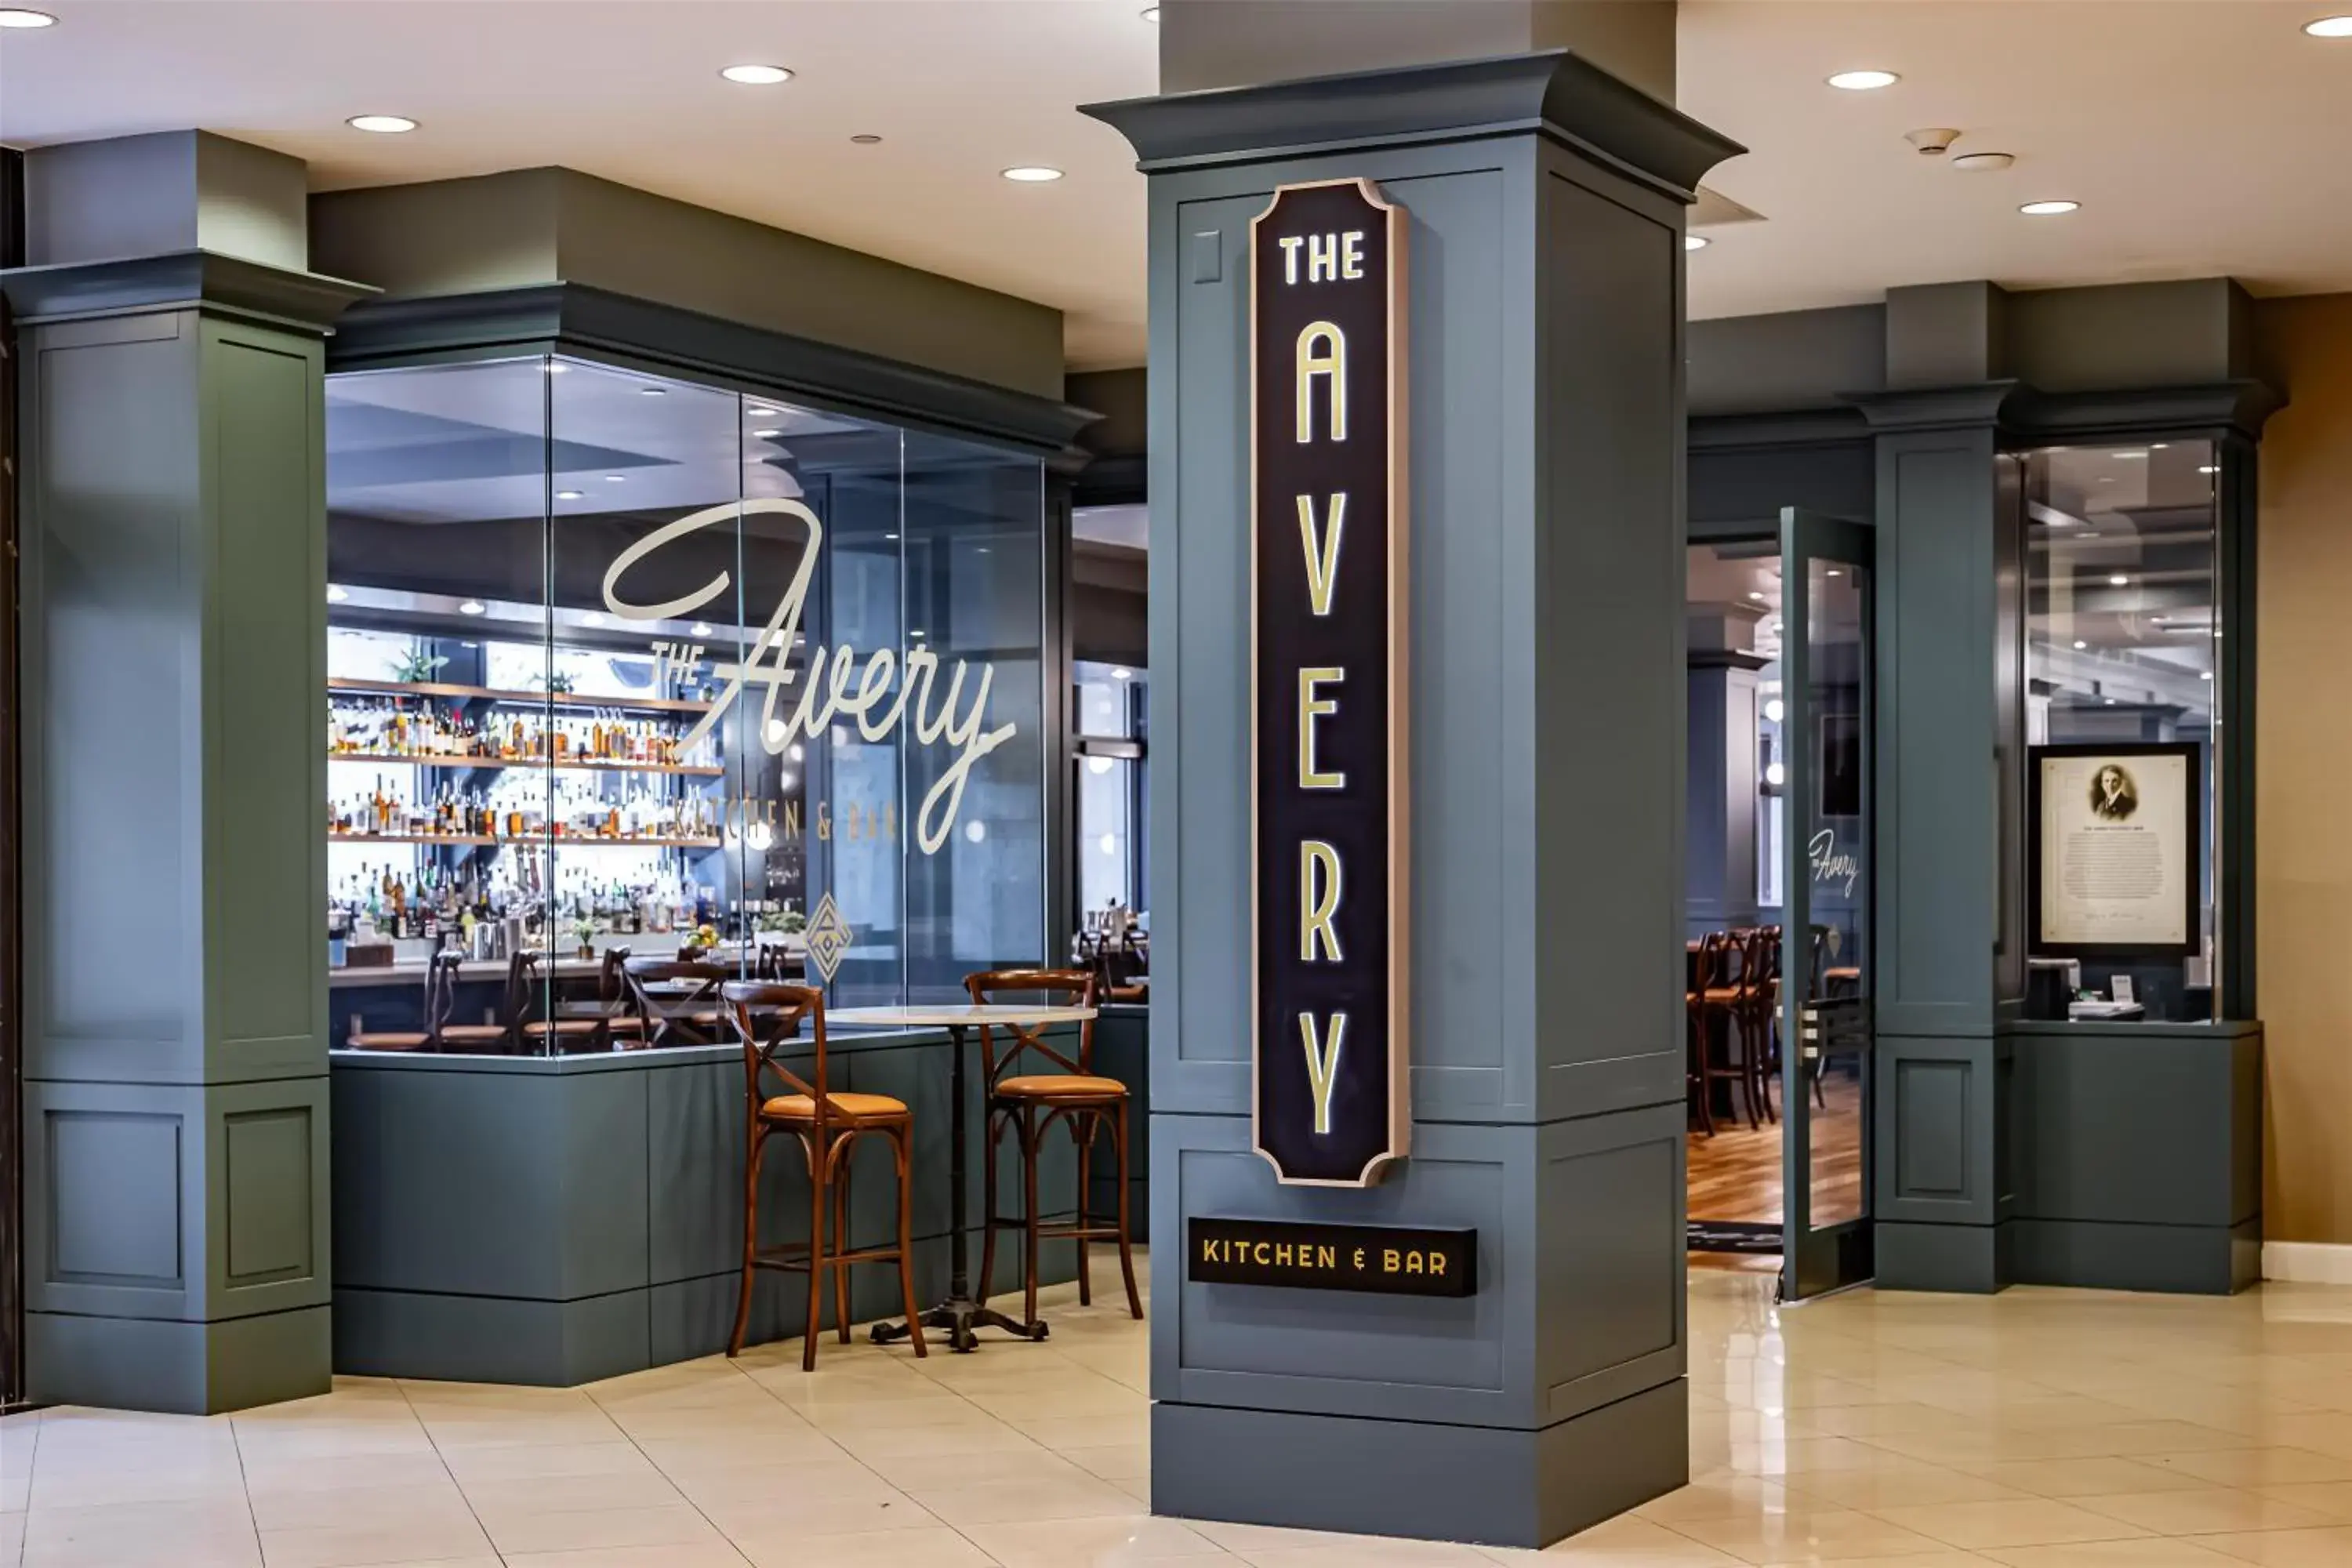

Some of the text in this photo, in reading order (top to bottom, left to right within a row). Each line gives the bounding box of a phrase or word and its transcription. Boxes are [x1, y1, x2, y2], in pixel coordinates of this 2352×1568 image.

[1279, 231, 1364, 285] THE
[603, 498, 1017, 855] THE Avery
[1296, 321, 1348, 1134] AVERY
[674, 799, 799, 840] KITCHEN
[818, 801, 831, 840] &
[1809, 829, 1860, 898] Avery
[1203, 1240, 1446, 1276] KITCHEN & BAR
